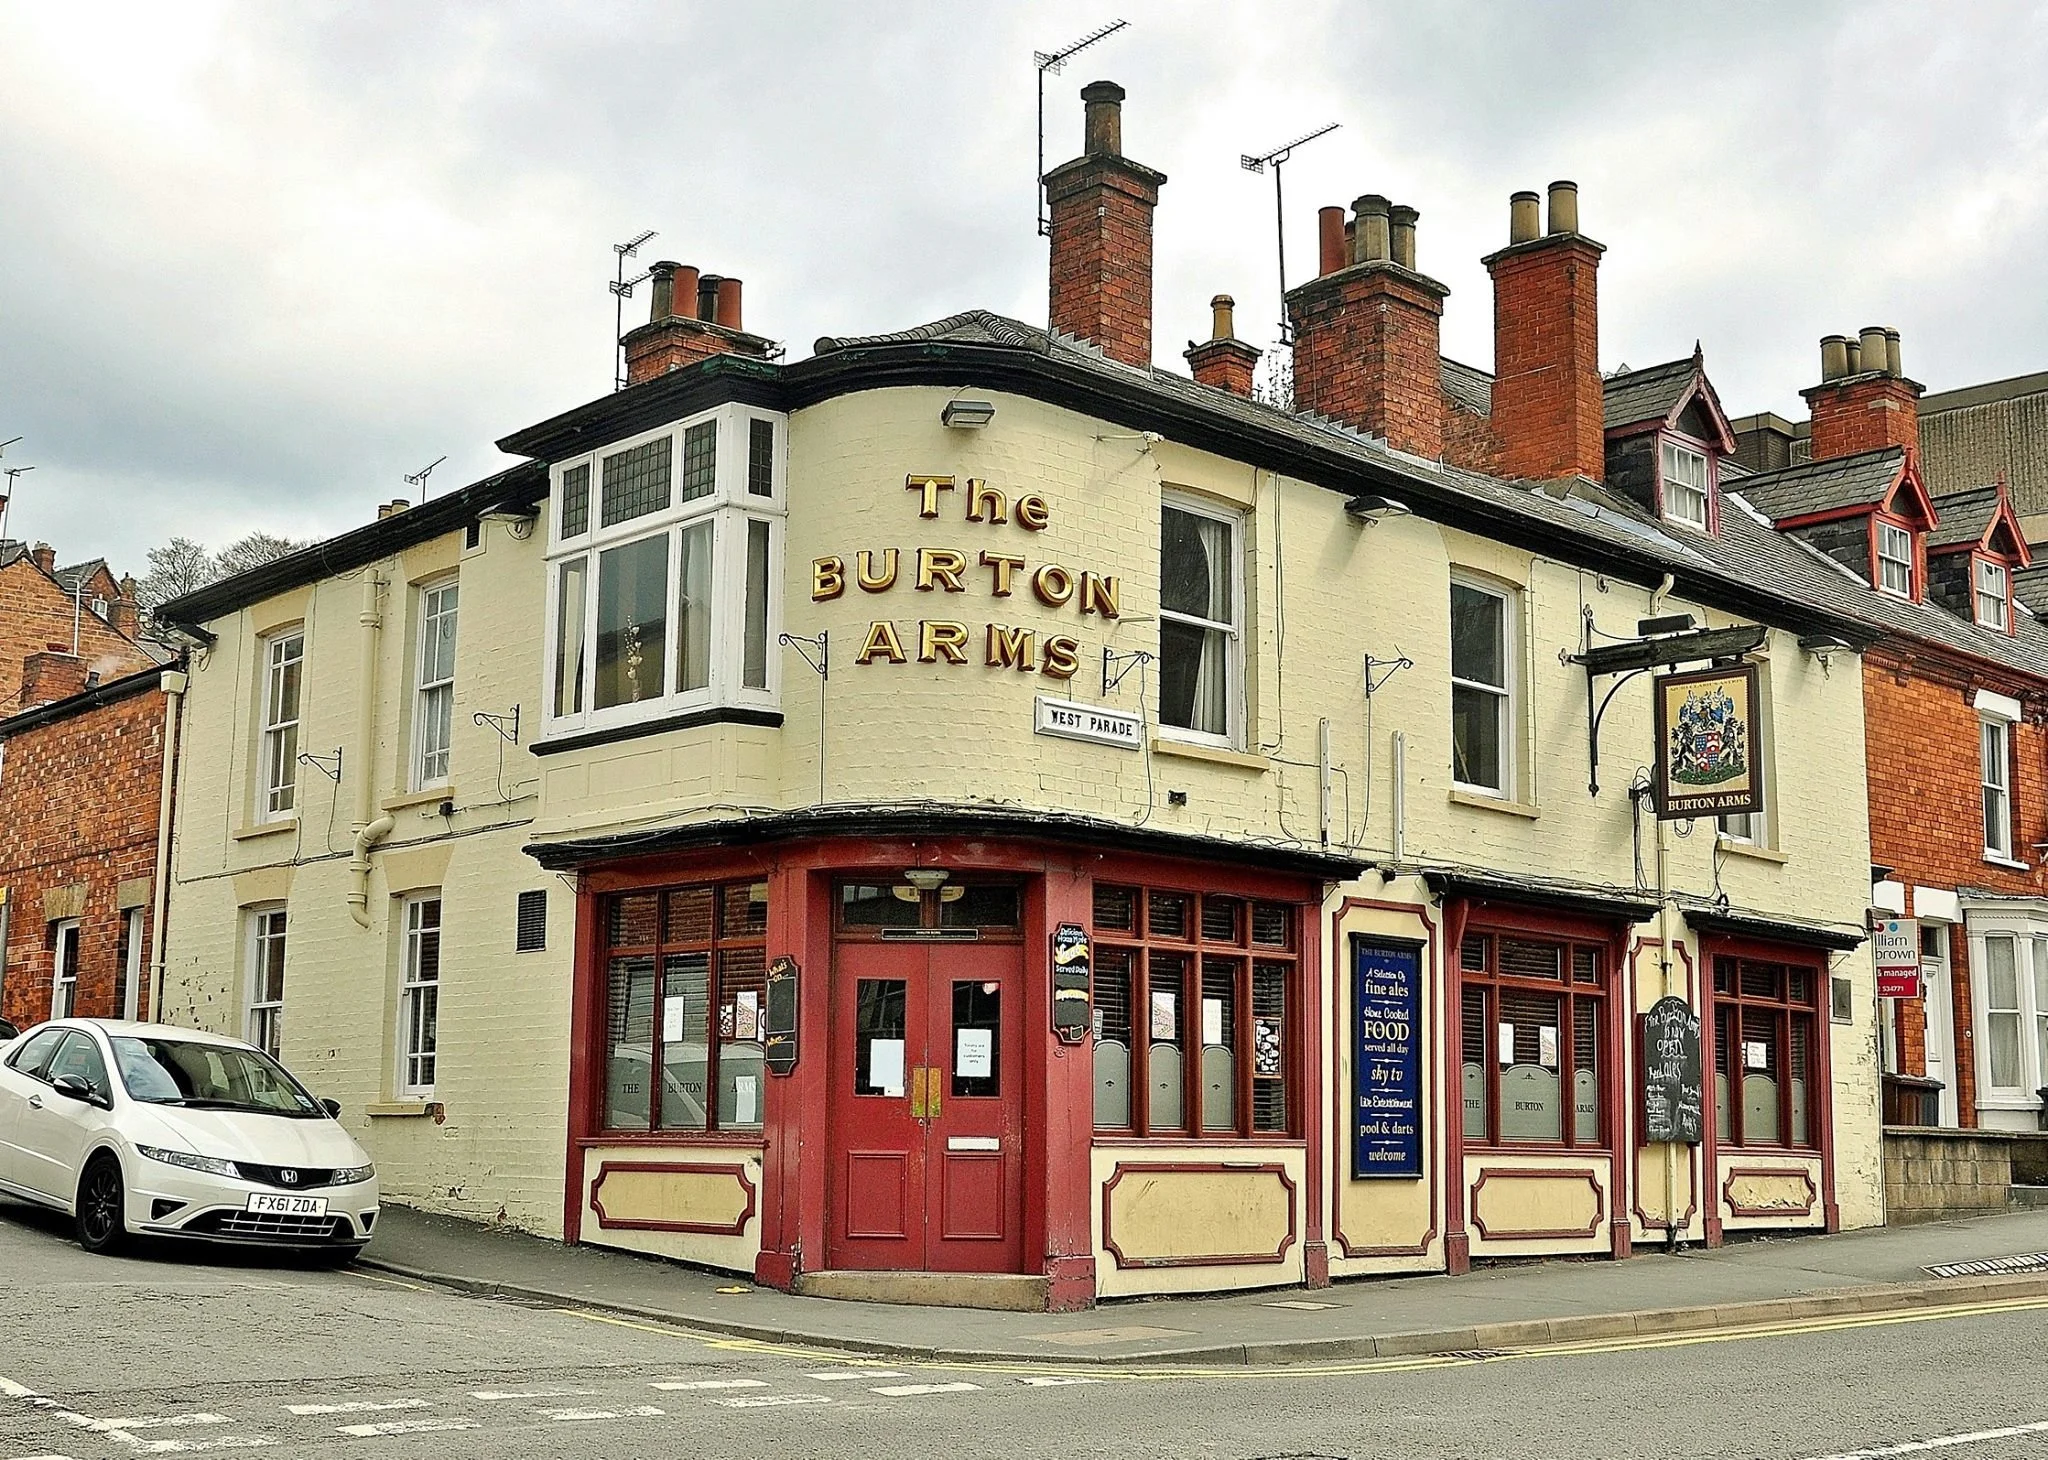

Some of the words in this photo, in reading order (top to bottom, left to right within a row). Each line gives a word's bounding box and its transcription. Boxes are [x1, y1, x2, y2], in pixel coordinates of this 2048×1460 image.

[905, 473, 1049, 531] The
[812, 548, 1119, 619] BURTON
[855, 620, 1080, 679] ARMS
[1051, 710, 1082, 728] WEST
[1090, 717, 1133, 736] PARADE
[1667, 797, 1716, 812] BURTON
[1717, 793, 1752, 807] ARMS
[1365, 967, 1374, 978] A
[1883, 967, 1917, 979] managed
[1365, 979, 1387, 996] fine
[1388, 981, 1409, 998] ales
[1383, 1007, 1410, 1021] Cooked
[1363, 1020, 1410, 1041] FOOD
[1364, 1043, 1386, 1053] served
[1387, 1042, 1396, 1053] all
[1396, 1043, 1409, 1056] day
[1370, 1064, 1389, 1086] sky
[1391, 1067, 1403, 1081] tv
[622, 1083, 640, 1094] THE
[667, 1082, 702, 1094] BURTON
[1464, 1099, 1480, 1109] THE
[1515, 1101, 1544, 1111] BURTON
[1575, 1103, 1595, 1114] ARMS
[1360, 1121, 1379, 1137] pool
[1381, 1121, 1390, 1134] &
[1391, 1121, 1414, 1135] darts
[1368, 1147, 1407, 1161] welcome
[257, 1196, 290, 1212] FX61
[291, 1198, 317, 1213] ZDA
